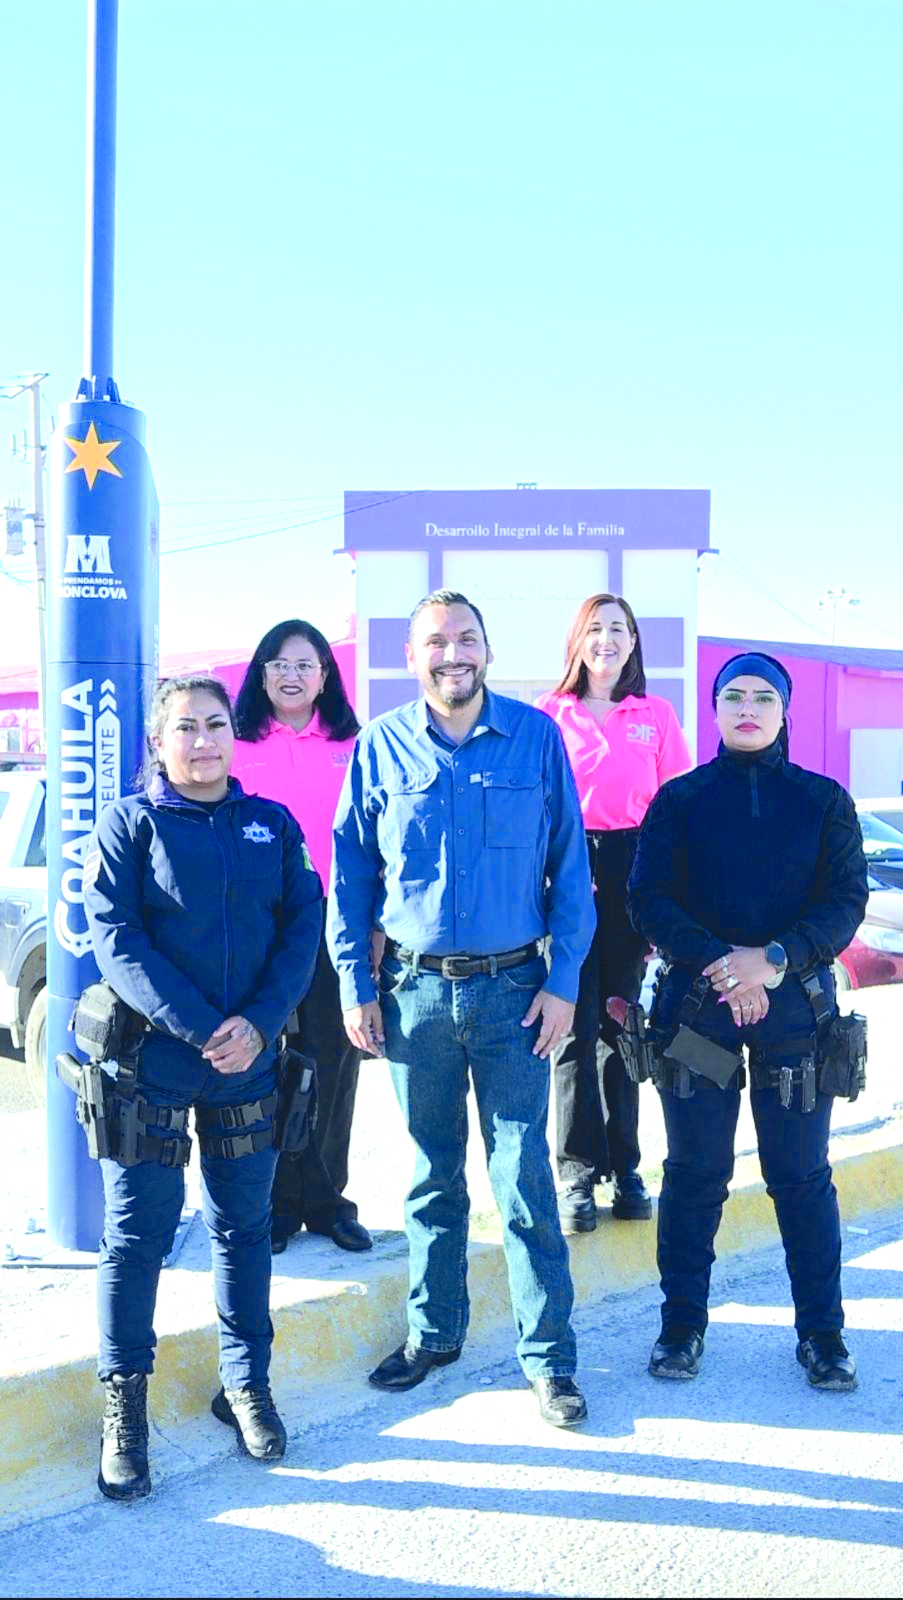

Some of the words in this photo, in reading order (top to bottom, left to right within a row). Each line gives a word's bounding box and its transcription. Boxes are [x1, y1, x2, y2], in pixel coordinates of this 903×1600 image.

[425, 523, 489, 536] Desarrollo
[494, 523, 541, 539] Integral
[544, 524, 559, 536] de
[563, 524, 573, 536] la
[577, 522, 625, 536] Familia
[101, 728, 115, 811] ELANTE
